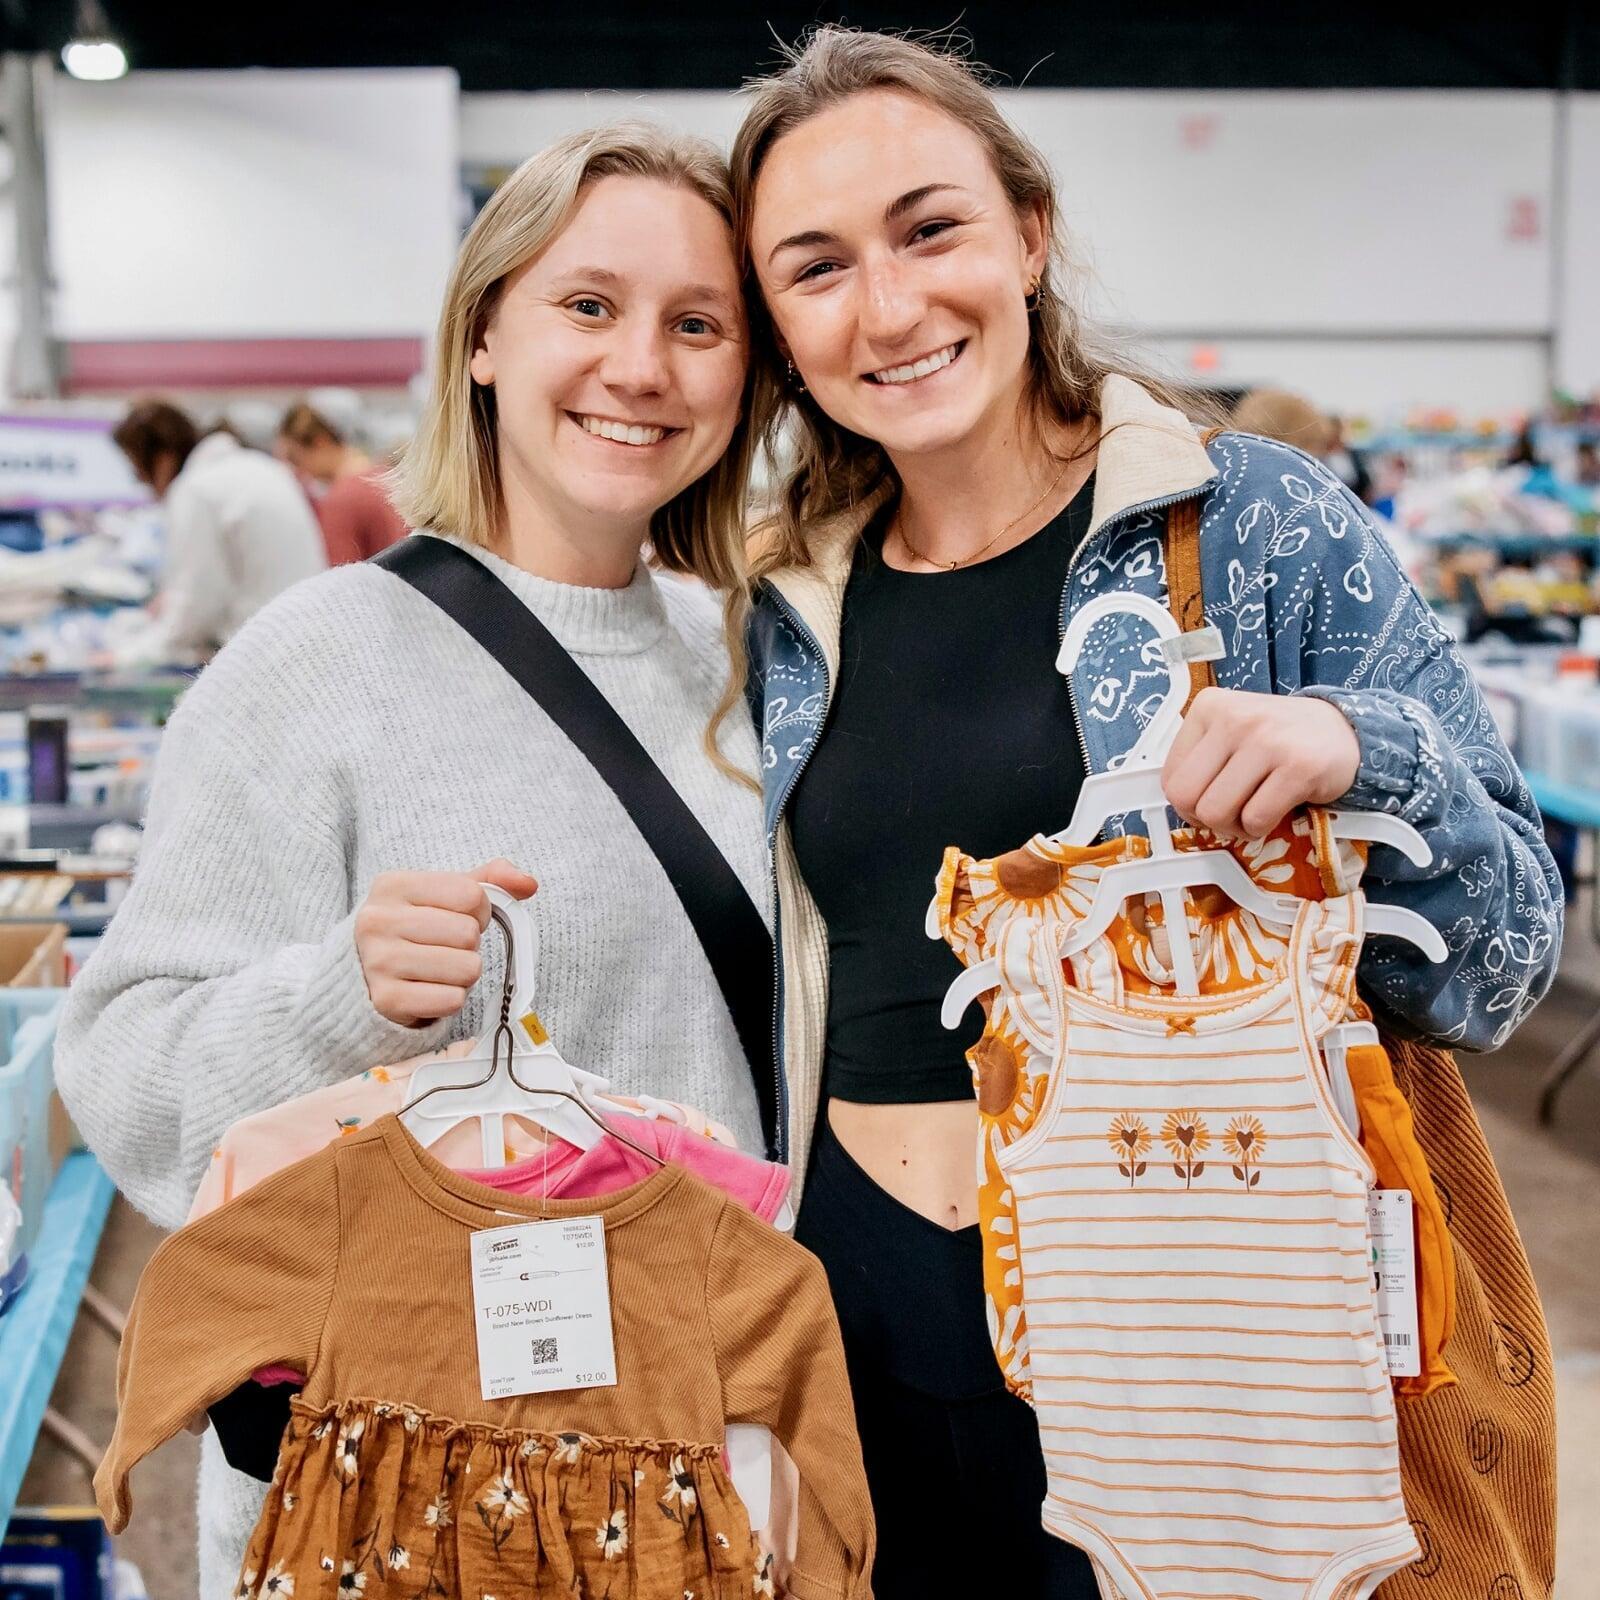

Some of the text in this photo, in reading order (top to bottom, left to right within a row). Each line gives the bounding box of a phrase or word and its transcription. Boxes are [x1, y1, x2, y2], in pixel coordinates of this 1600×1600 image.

[483, 1299, 552, 1319] T-075-WDI
[492, 1321, 510, 1330] Brand
[545, 1315, 574, 1323] Sunflower
[575, 1312, 593, 1320] Dress
[575, 1371, 607, 1384] $12.00
[490, 1386, 513, 1396] 6 mo
